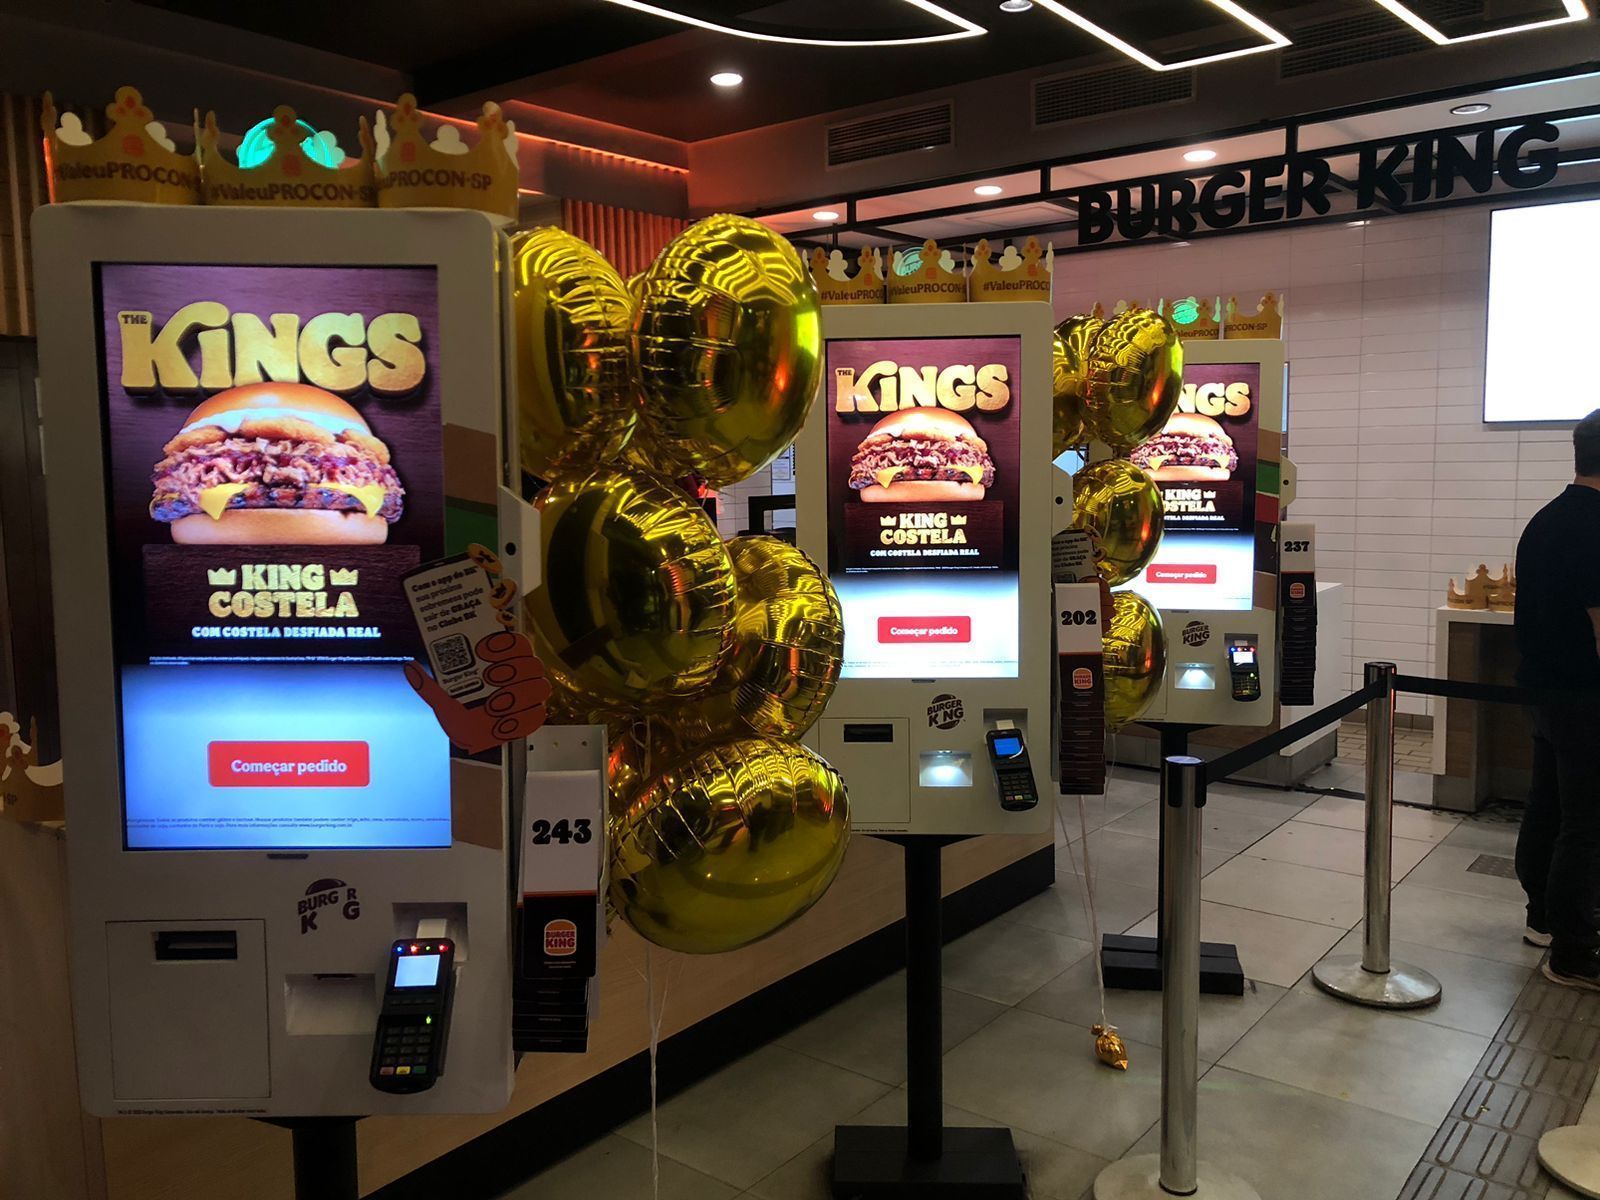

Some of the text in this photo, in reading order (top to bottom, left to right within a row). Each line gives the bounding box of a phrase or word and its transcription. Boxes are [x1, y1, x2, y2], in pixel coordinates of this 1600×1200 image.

[1078, 119, 1561, 245] BURGER KING
[121, 313, 148, 325] THE
[1174, 382, 1251, 417] NGS
[1165, 488, 1202, 501] KING
[1163, 500, 1216, 513] OSTELA
[899, 512, 948, 529] KING
[880, 528, 967, 545] COSTELA
[887, 549, 922, 557] COSTELA
[922, 548, 959, 556] DESFIADA
[959, 548, 980, 556] REAL
[1284, 540, 1310, 553] 237
[241, 563, 325, 591] KING
[411, 582, 431, 592] Com
[463, 587, 484, 600] pode
[207, 590, 360, 618] COSTELA
[450, 598, 482, 613] GRAÇA
[427, 624, 438, 632] no
[438, 615, 463, 628] Clube
[1060, 609, 1097, 626] 202
[222, 626, 282, 638] COSTELA
[283, 626, 345, 638] DESFIADA
[346, 626, 381, 638] REAL
[890, 627, 959, 638] Começar pedido
[1181, 625, 1209, 637] BURGER
[1182, 630, 1210, 645] KING
[927, 699, 963, 716] BURGER
[928, 707, 965, 728] KNG
[230, 759, 347, 776] Começar pedido
[531, 818, 593, 845] 243
[297, 887, 358, 916] BURGR
[301, 900, 361, 935] KG
[545, 930, 576, 938] BURGER
[545, 938, 576, 948] KING
